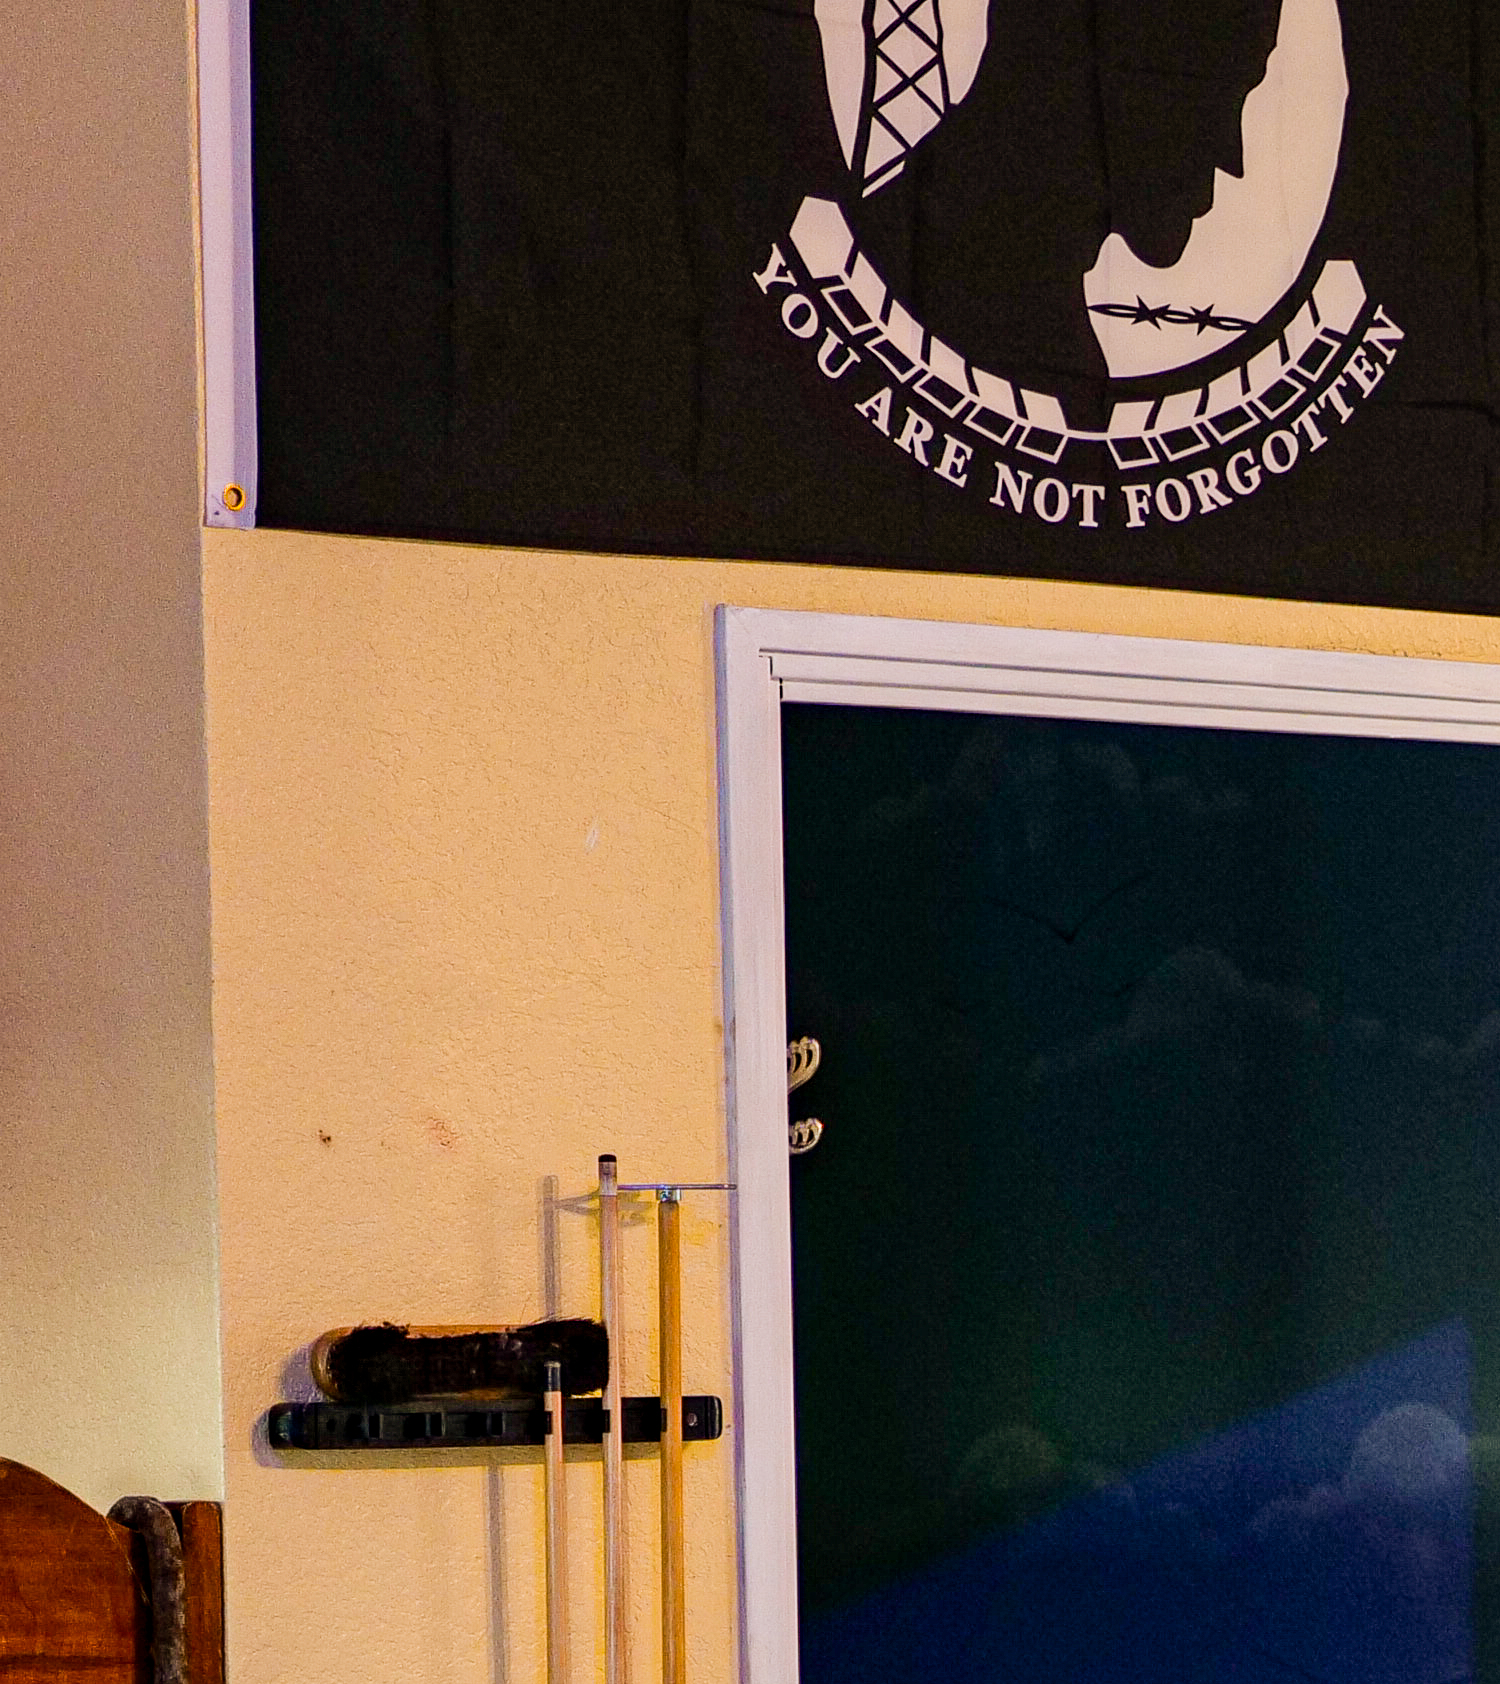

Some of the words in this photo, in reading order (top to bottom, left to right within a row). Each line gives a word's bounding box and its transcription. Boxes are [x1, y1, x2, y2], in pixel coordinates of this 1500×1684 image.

[752, 242, 861, 380] YOU
[857, 387, 974, 488] ARE
[990, 462, 1106, 528] NOT
[1121, 305, 1406, 528] FORGOTTEN
